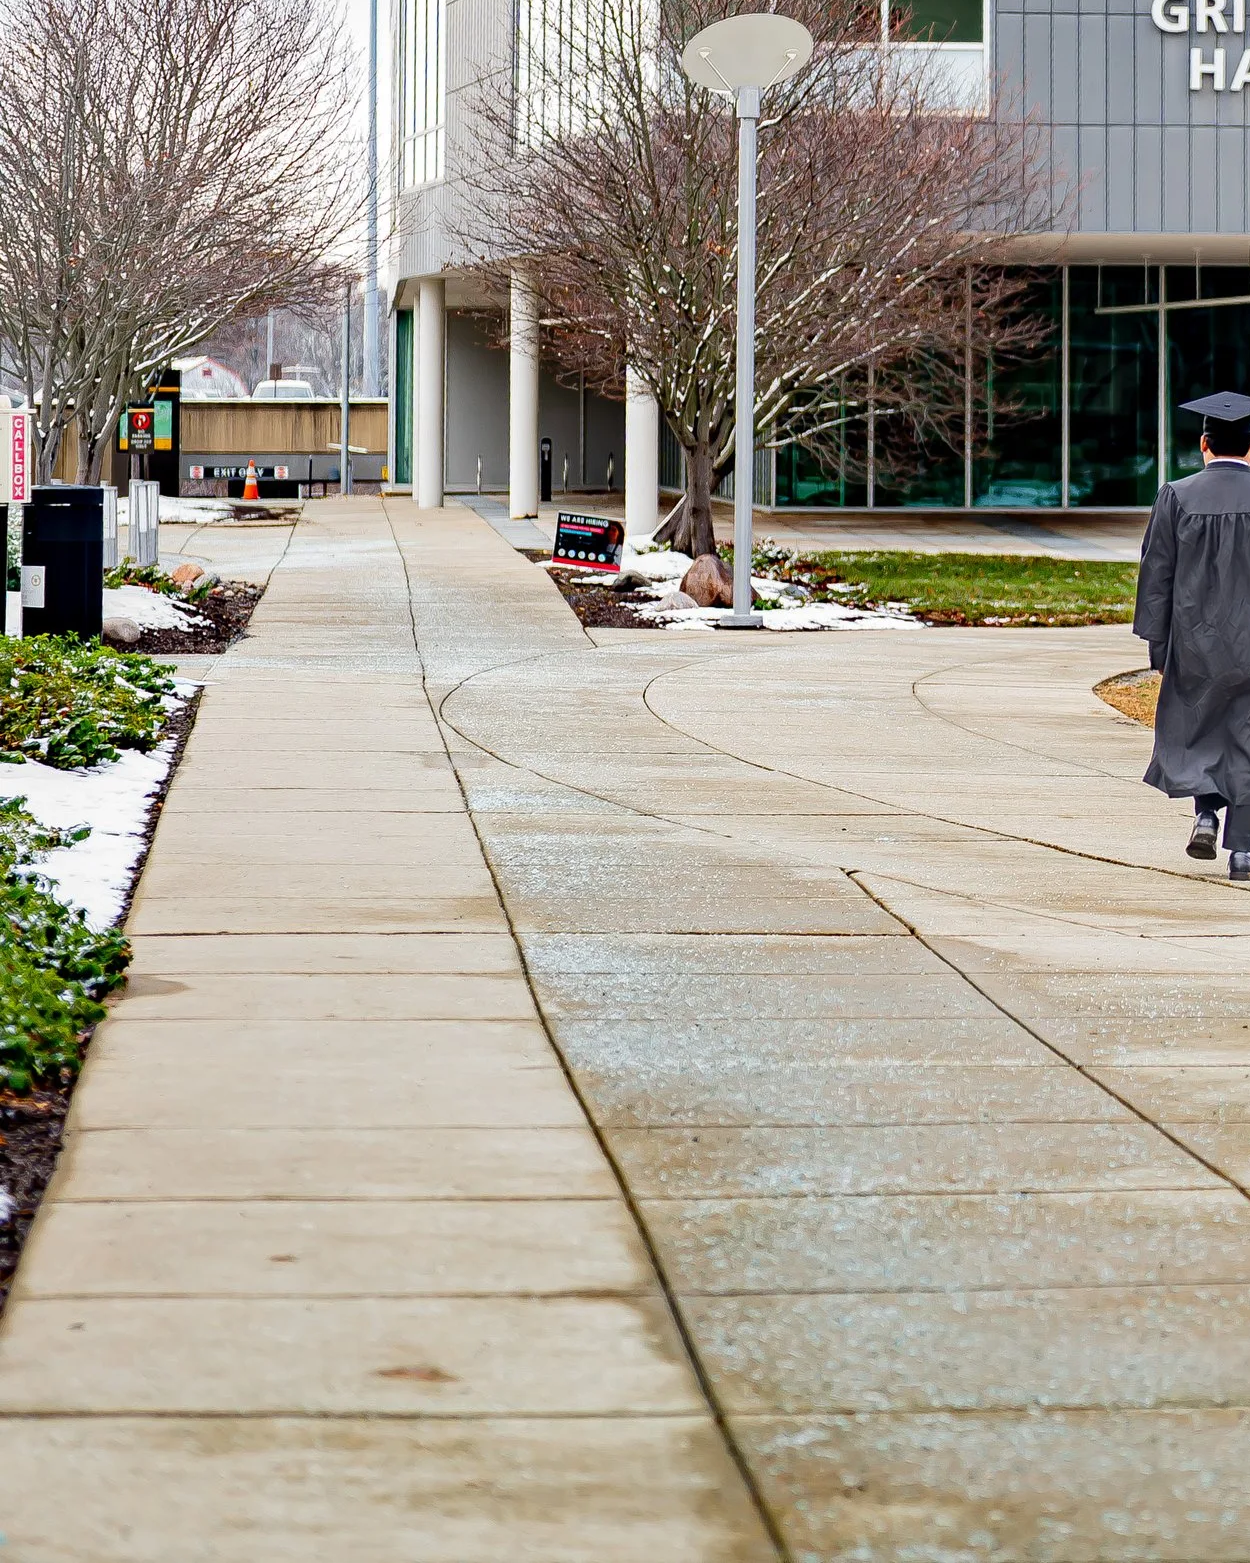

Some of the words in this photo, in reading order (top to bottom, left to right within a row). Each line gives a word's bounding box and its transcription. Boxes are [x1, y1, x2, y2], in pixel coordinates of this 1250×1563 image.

[14, 418, 23, 497] CALLBOX
[213, 467, 237, 478] EXIT
[238, 467, 264, 478] OY
[572, 516, 585, 524] ARE
[586, 518, 609, 528] HIRING
